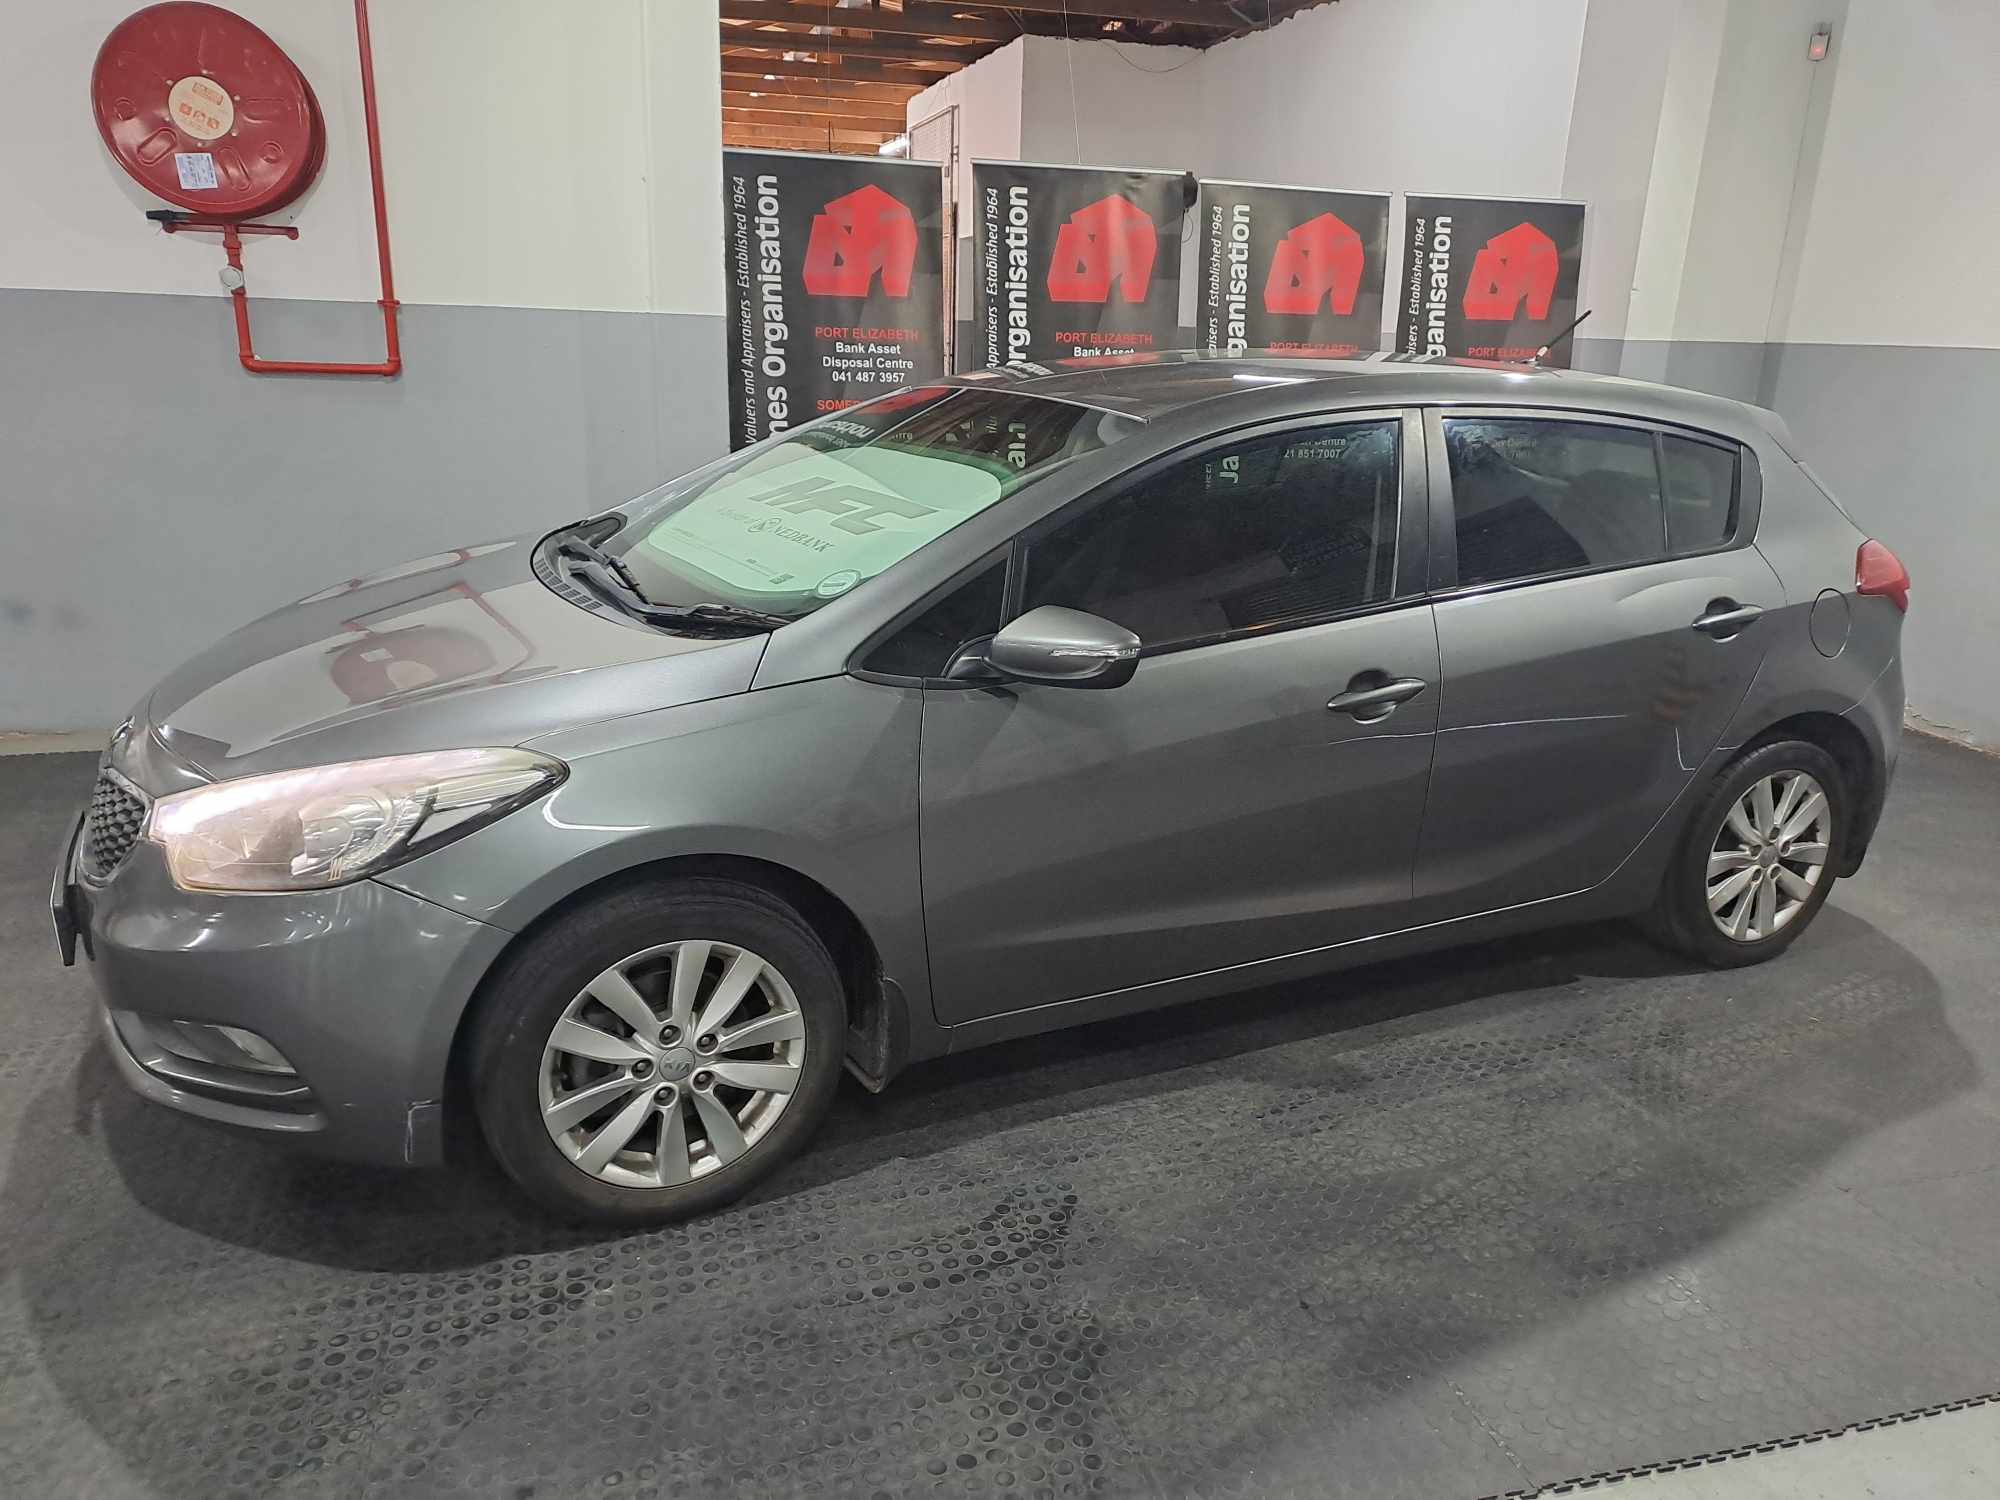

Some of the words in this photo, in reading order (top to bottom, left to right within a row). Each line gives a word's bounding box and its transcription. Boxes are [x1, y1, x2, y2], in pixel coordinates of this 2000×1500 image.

[733, 176, 745, 209] 1964
[986, 187, 999, 219] 1964
[1212, 205, 1223, 236] 1964
[1414, 218, 1426, 246] 1964
[735, 214, 750, 288] Established
[985, 223, 999, 295] Established
[755, 174, 788, 377] Organisation
[1209, 238, 1222, 306] Established
[1409, 249, 1423, 315] Established
[739, 300, 755, 366] Appraisers
[815, 327, 848, 338] PORT
[852, 328, 919, 341] ELIZABETH
[835, 342, 866, 355] Bank
[868, 342, 901, 355] Asset
[985, 306, 999, 369] Appraisers
[1056, 331, 1088, 343] PORT
[1090, 332, 1152, 344] ELIZABETH
[822, 355, 873, 371] Disposal
[876, 357, 914, 370] Centre
[1073, 347, 1100, 357] Bank
[1468, 347, 1495, 357] PORT
[741, 369, 755, 394] and
[832, 371, 852, 383] 041
[855, 371, 876, 383] 487
[879, 372, 905, 384] 3957
[743, 398, 757, 443] Valuers
